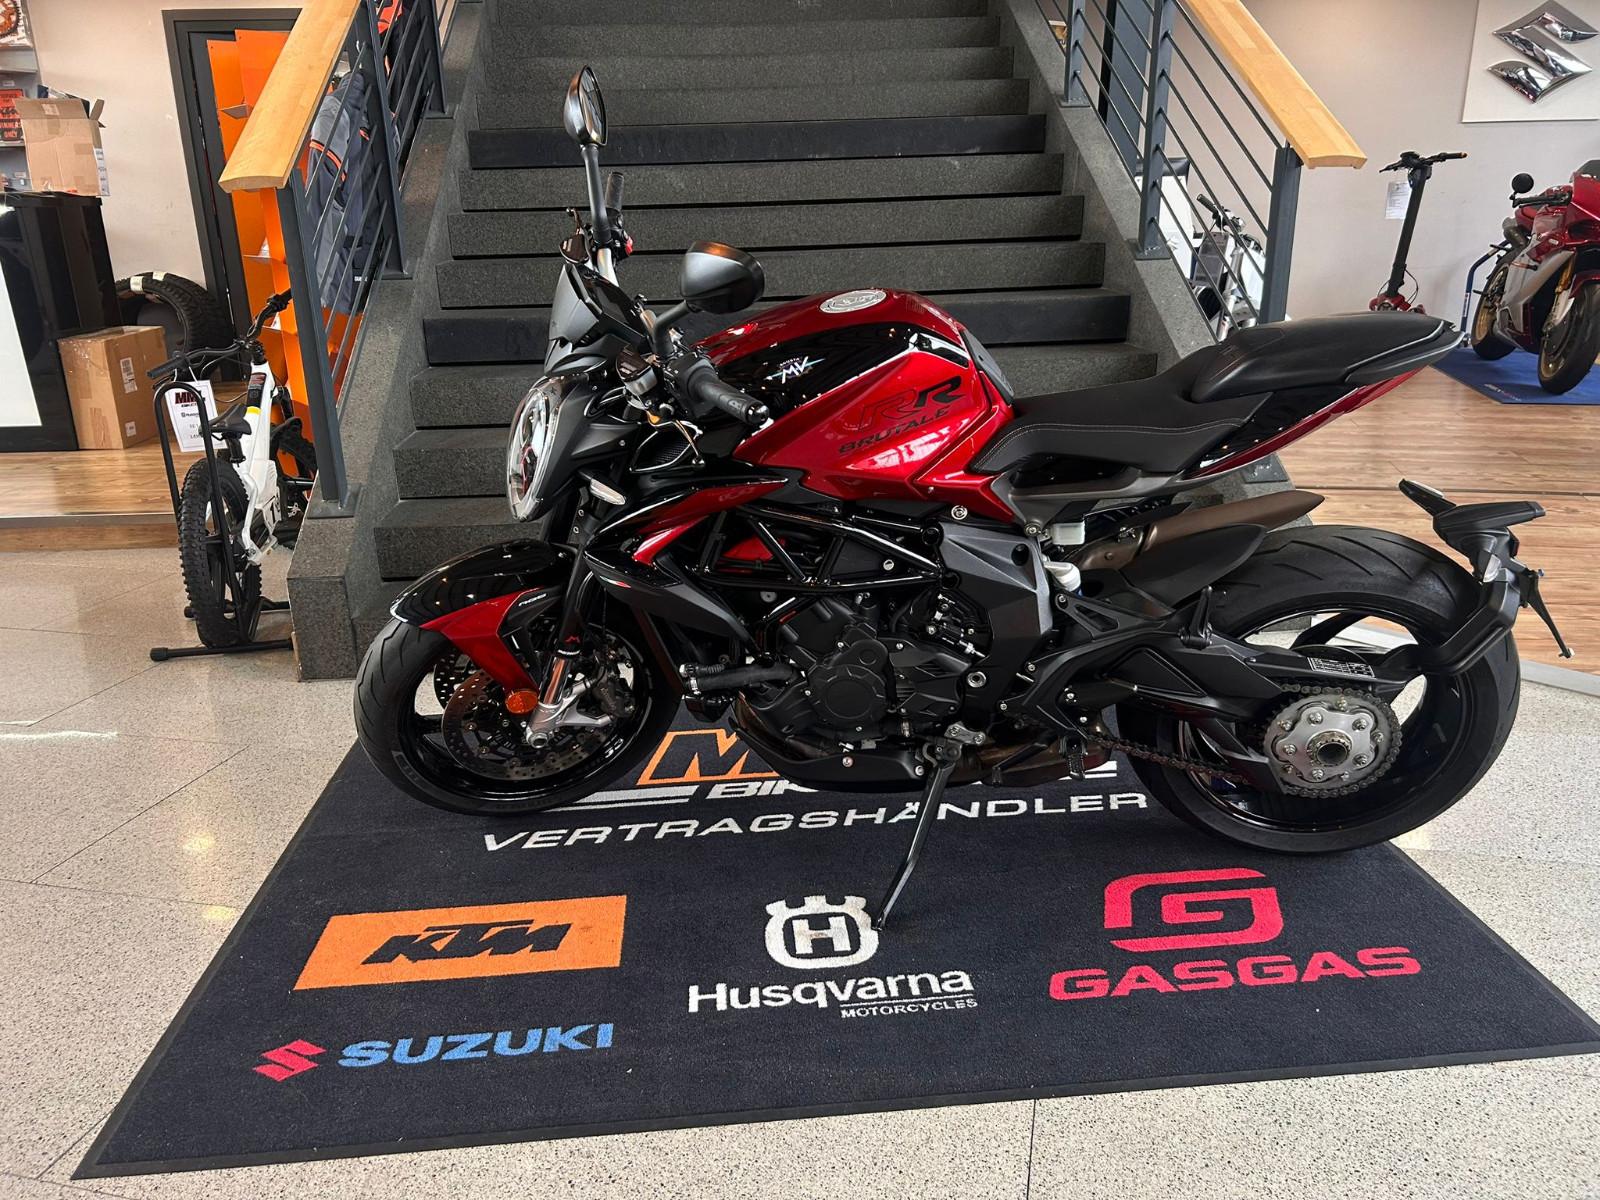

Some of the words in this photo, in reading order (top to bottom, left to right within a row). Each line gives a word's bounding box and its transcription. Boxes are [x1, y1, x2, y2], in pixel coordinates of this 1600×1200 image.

[837, 404, 952, 454] BRUTALE
[484, 793, 1148, 851] VERTRAGSHÄNDLER
[360, 919, 574, 965] KTM
[688, 970, 975, 1013] Husqvarna
[1049, 946, 1422, 1000] GASGAS
[841, 999, 979, 1018] MOTORCYCLES
[337, 1023, 614, 1068] SUZUKI
